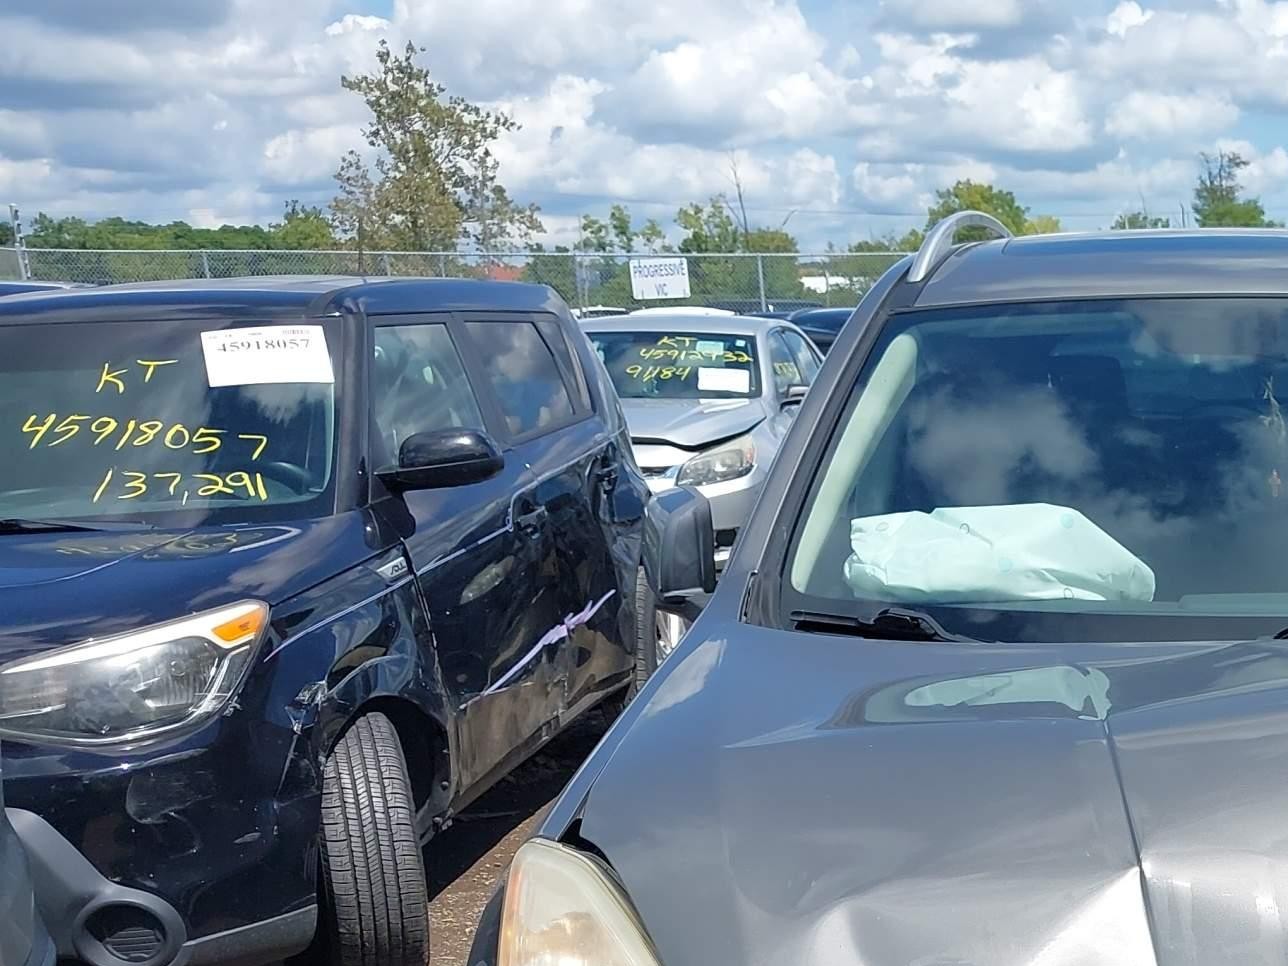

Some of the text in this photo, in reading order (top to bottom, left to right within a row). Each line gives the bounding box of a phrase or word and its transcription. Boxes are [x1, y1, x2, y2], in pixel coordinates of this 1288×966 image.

[633, 261, 686, 278] PROGRESSIVE
[217, 338, 310, 353] 45918057
[21, 413, 267, 460] 45918057
[93, 466, 267, 505] 137,291
